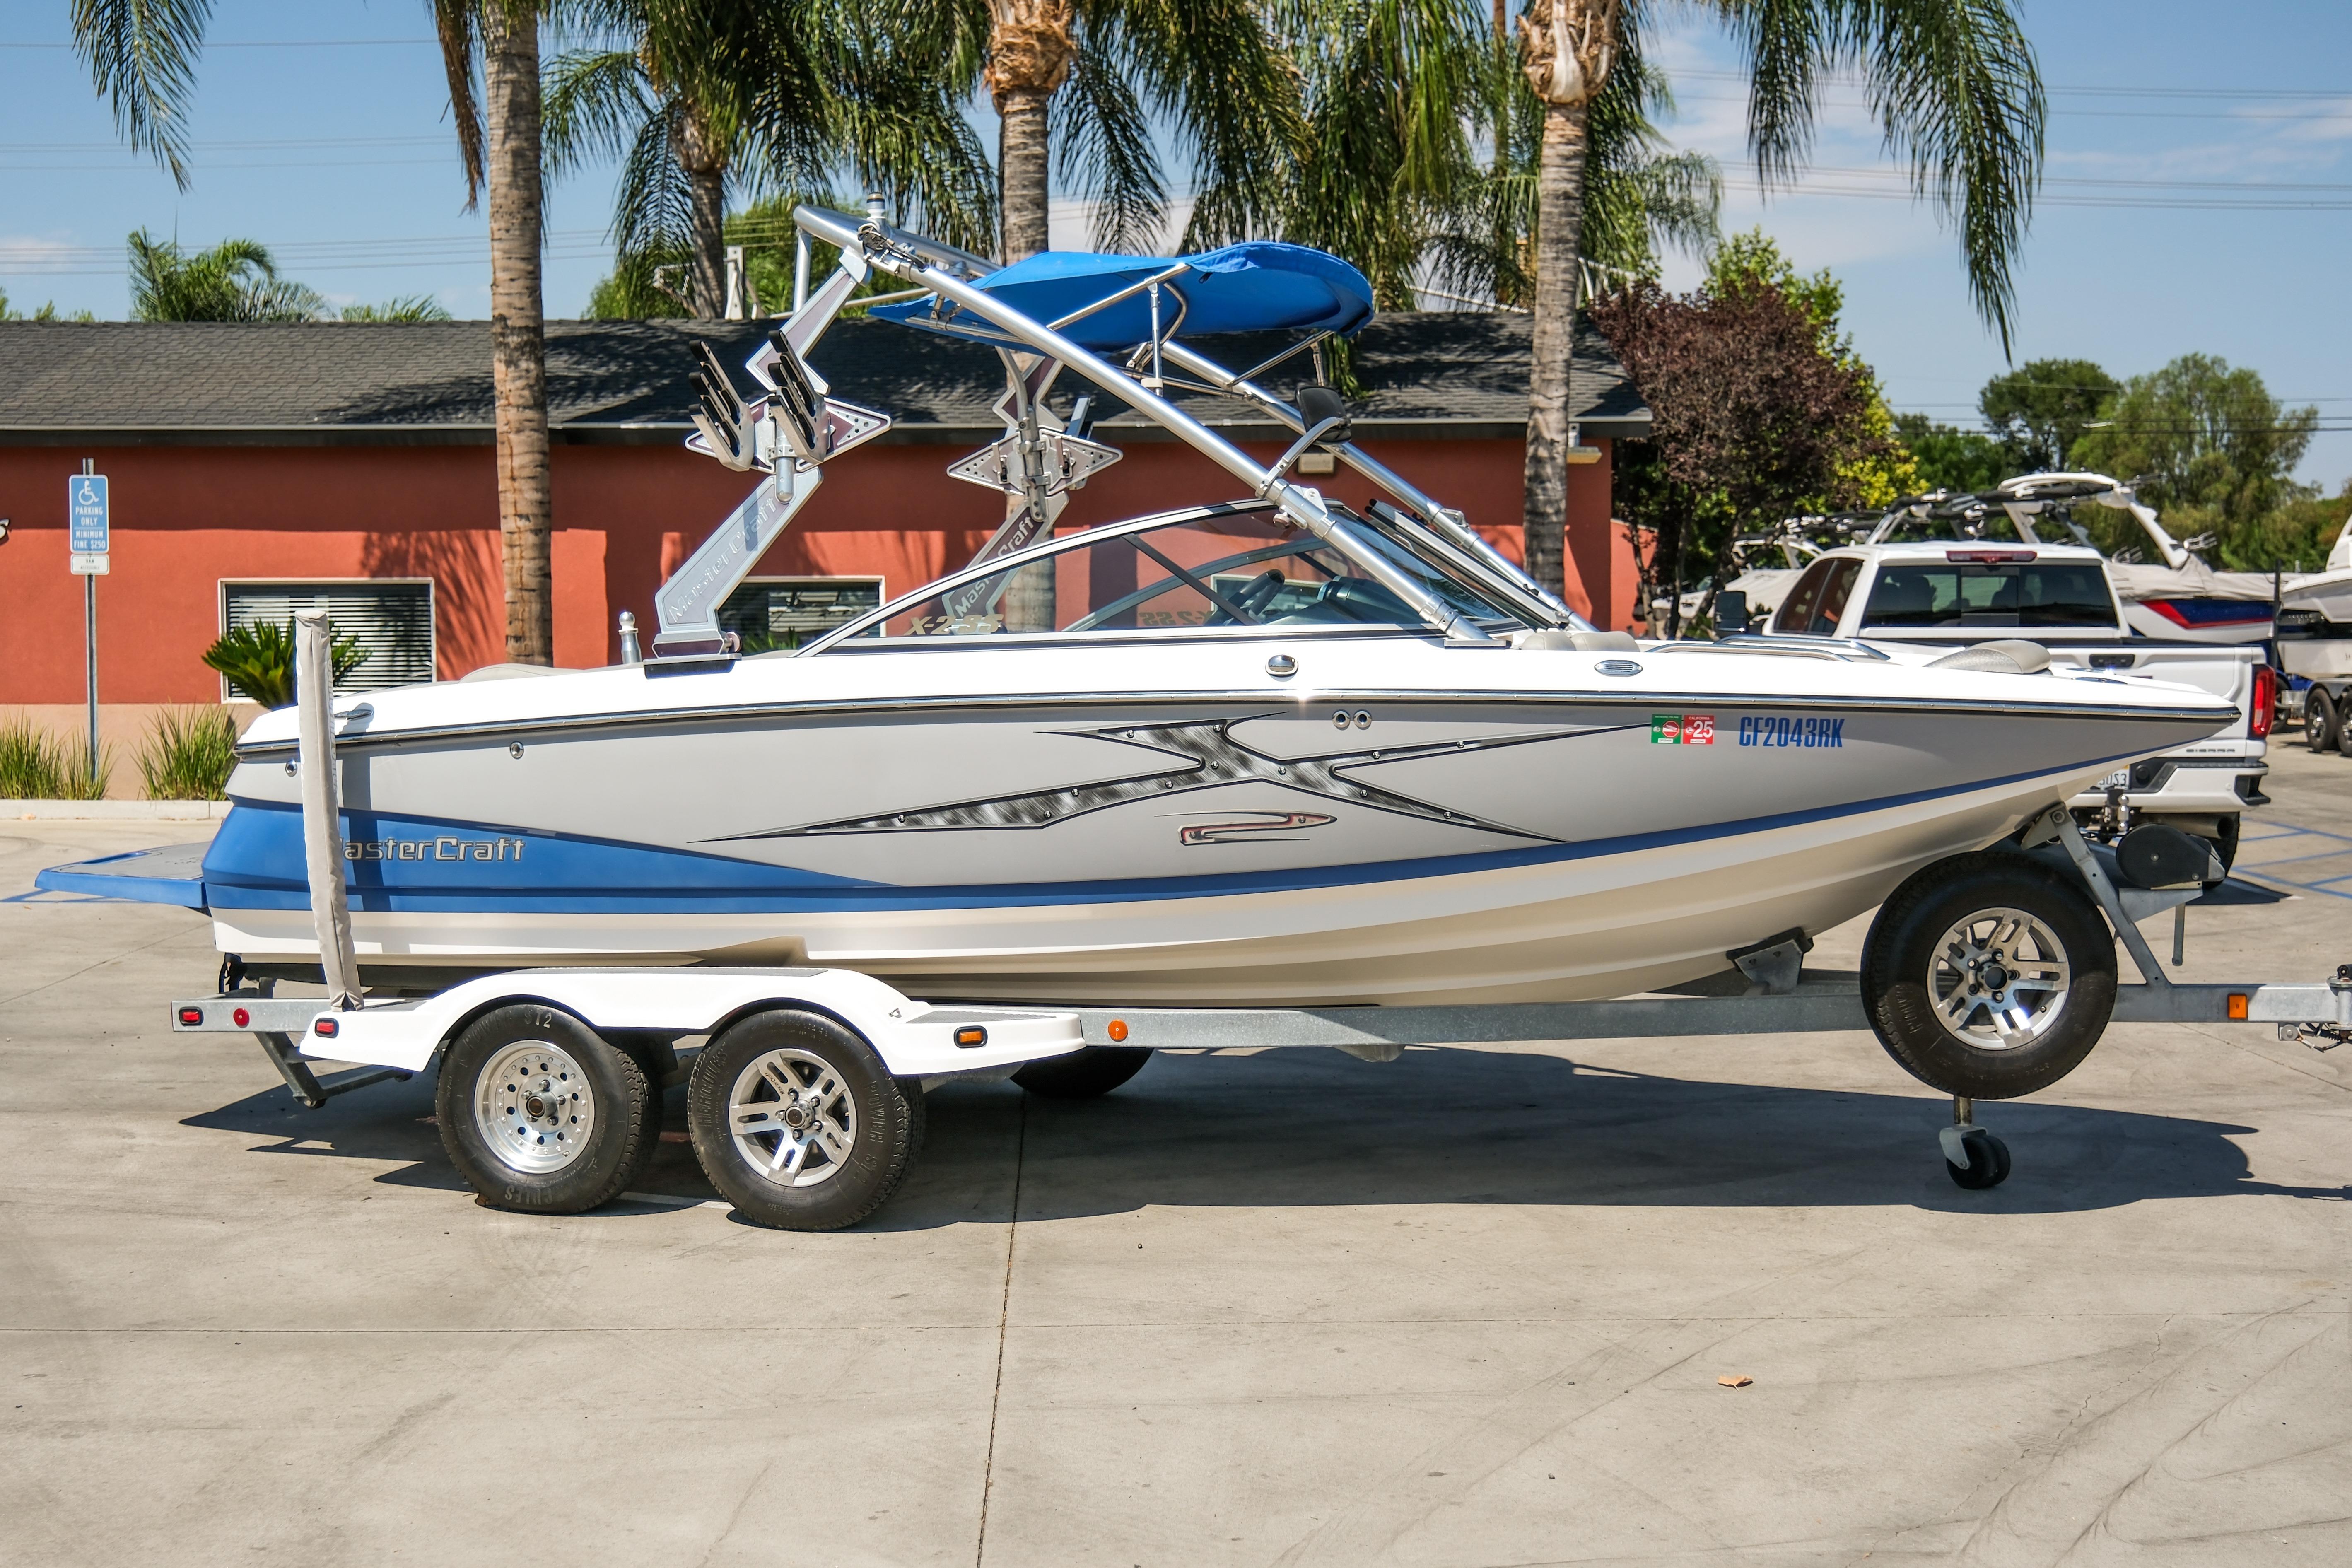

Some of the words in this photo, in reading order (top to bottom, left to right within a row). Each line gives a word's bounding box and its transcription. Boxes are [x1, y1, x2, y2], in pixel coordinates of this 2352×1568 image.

[75, 506, 103, 516] PARKING
[81, 516, 98, 526] ONLY
[76, 530, 104, 538] MINIMUM
[74, 540, 88, 549] FINE
[90, 540, 106, 550] $250
[669, 497, 777, 622] MasterCraft
[1693, 721, 1713, 738] 25
[1739, 716, 1845, 748] CF2043RK
[340, 836, 525, 861] asterCraft
